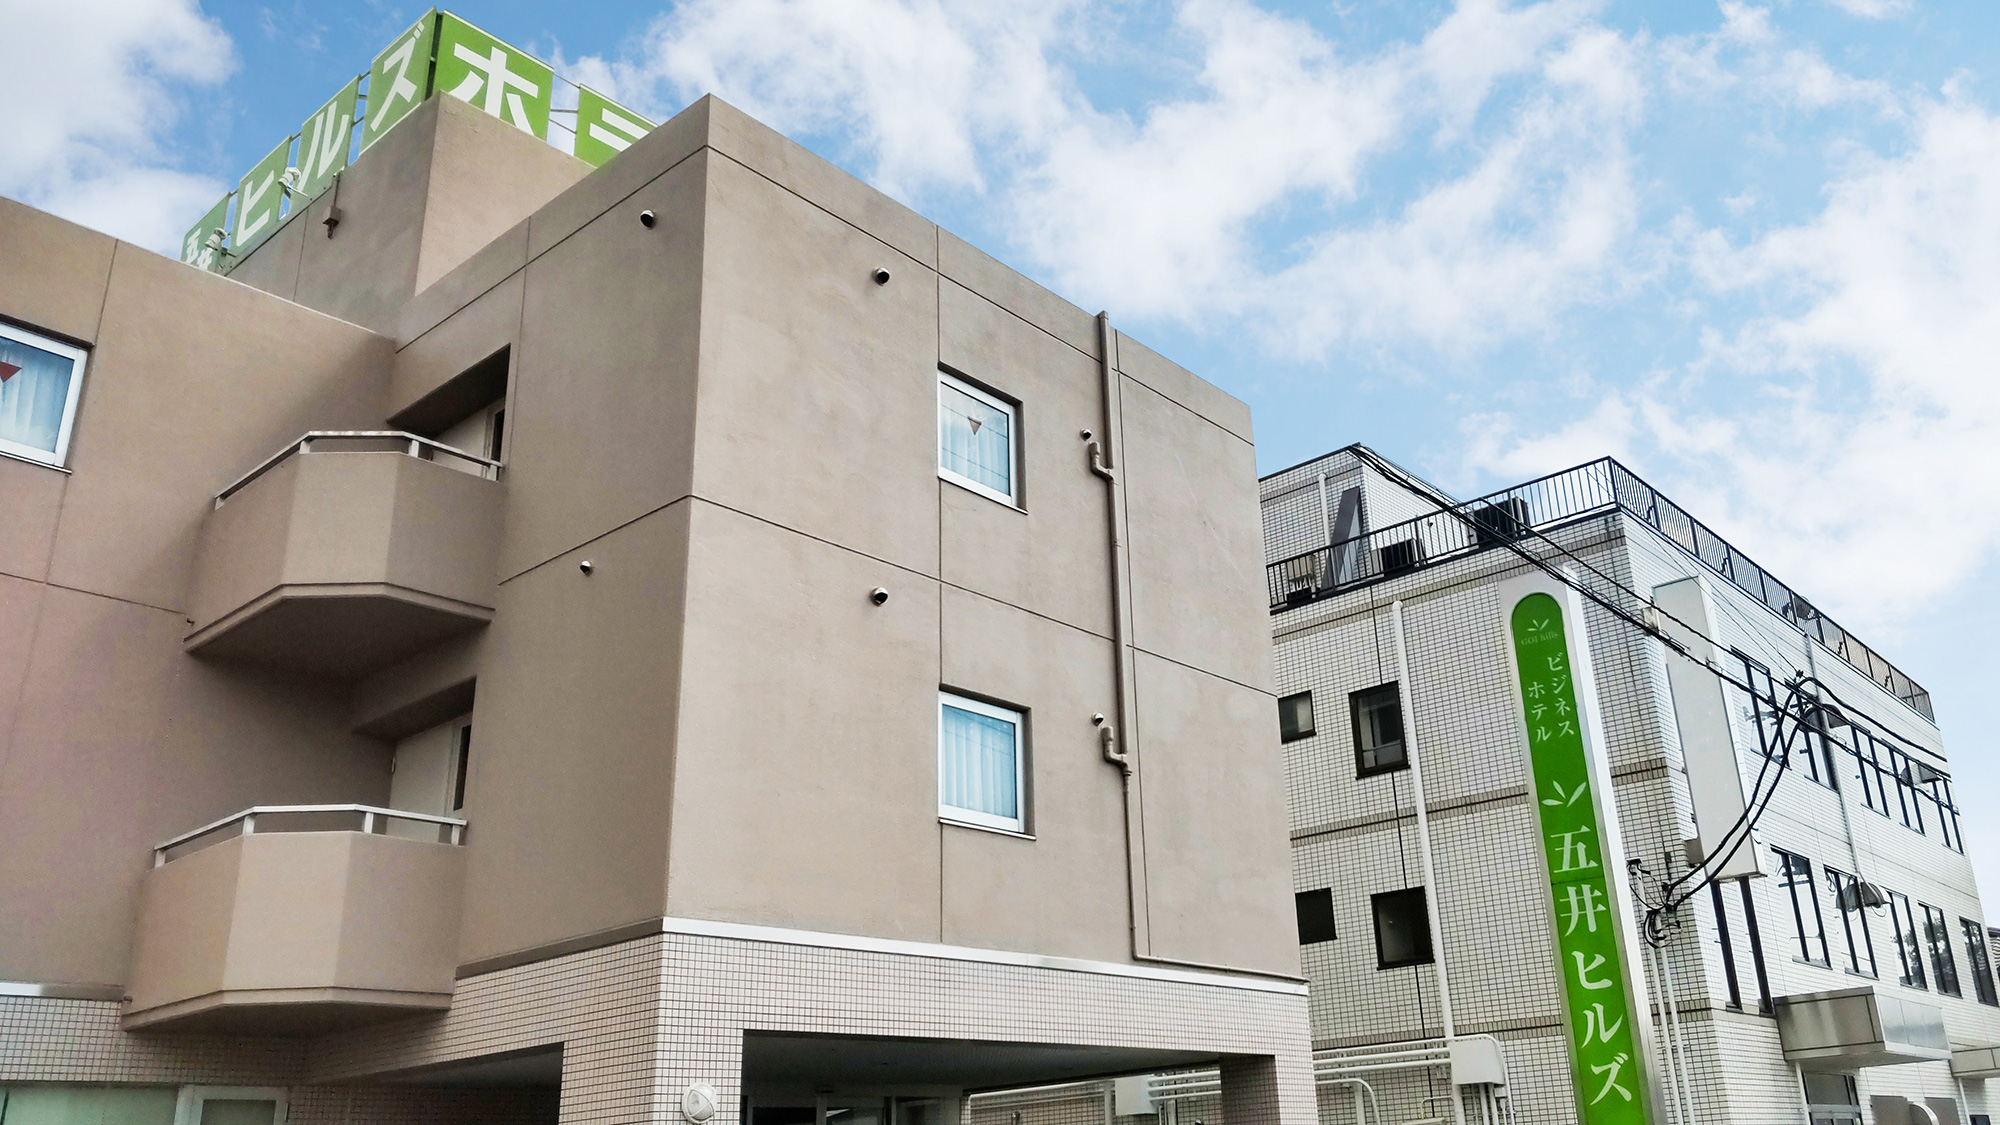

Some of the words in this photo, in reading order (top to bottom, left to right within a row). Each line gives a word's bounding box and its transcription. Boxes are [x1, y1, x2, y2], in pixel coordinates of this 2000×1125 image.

[1520, 635, 1538, 646] GOI
[1528, 681, 1551, 743] ホテル
[1547, 651, 1575, 737] ビジネス
[1550, 824, 1633, 1106] 五井ヒルズ
